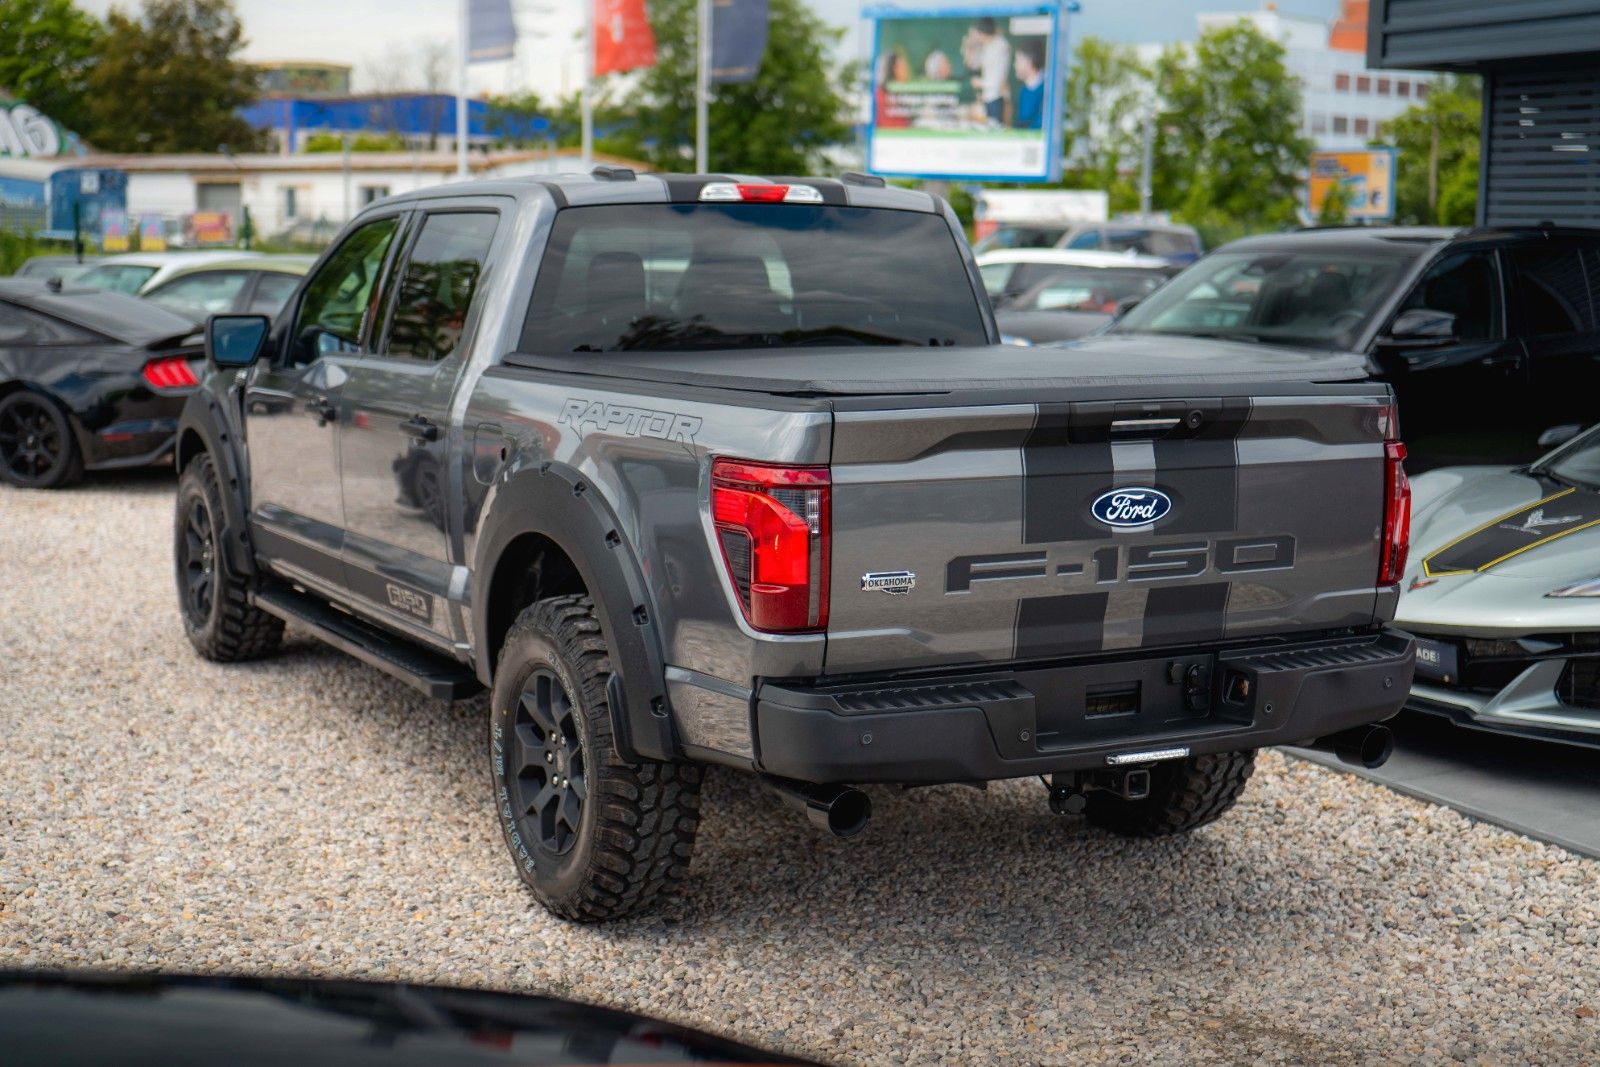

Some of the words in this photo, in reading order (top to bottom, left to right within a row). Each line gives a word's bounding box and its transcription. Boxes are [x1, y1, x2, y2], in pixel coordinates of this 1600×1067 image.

[558, 398, 703, 463] RAPTOR
[1106, 494, 1158, 520] Ford
[868, 577, 913, 588] OKLAHOMA
[944, 534, 1297, 596] F-150
